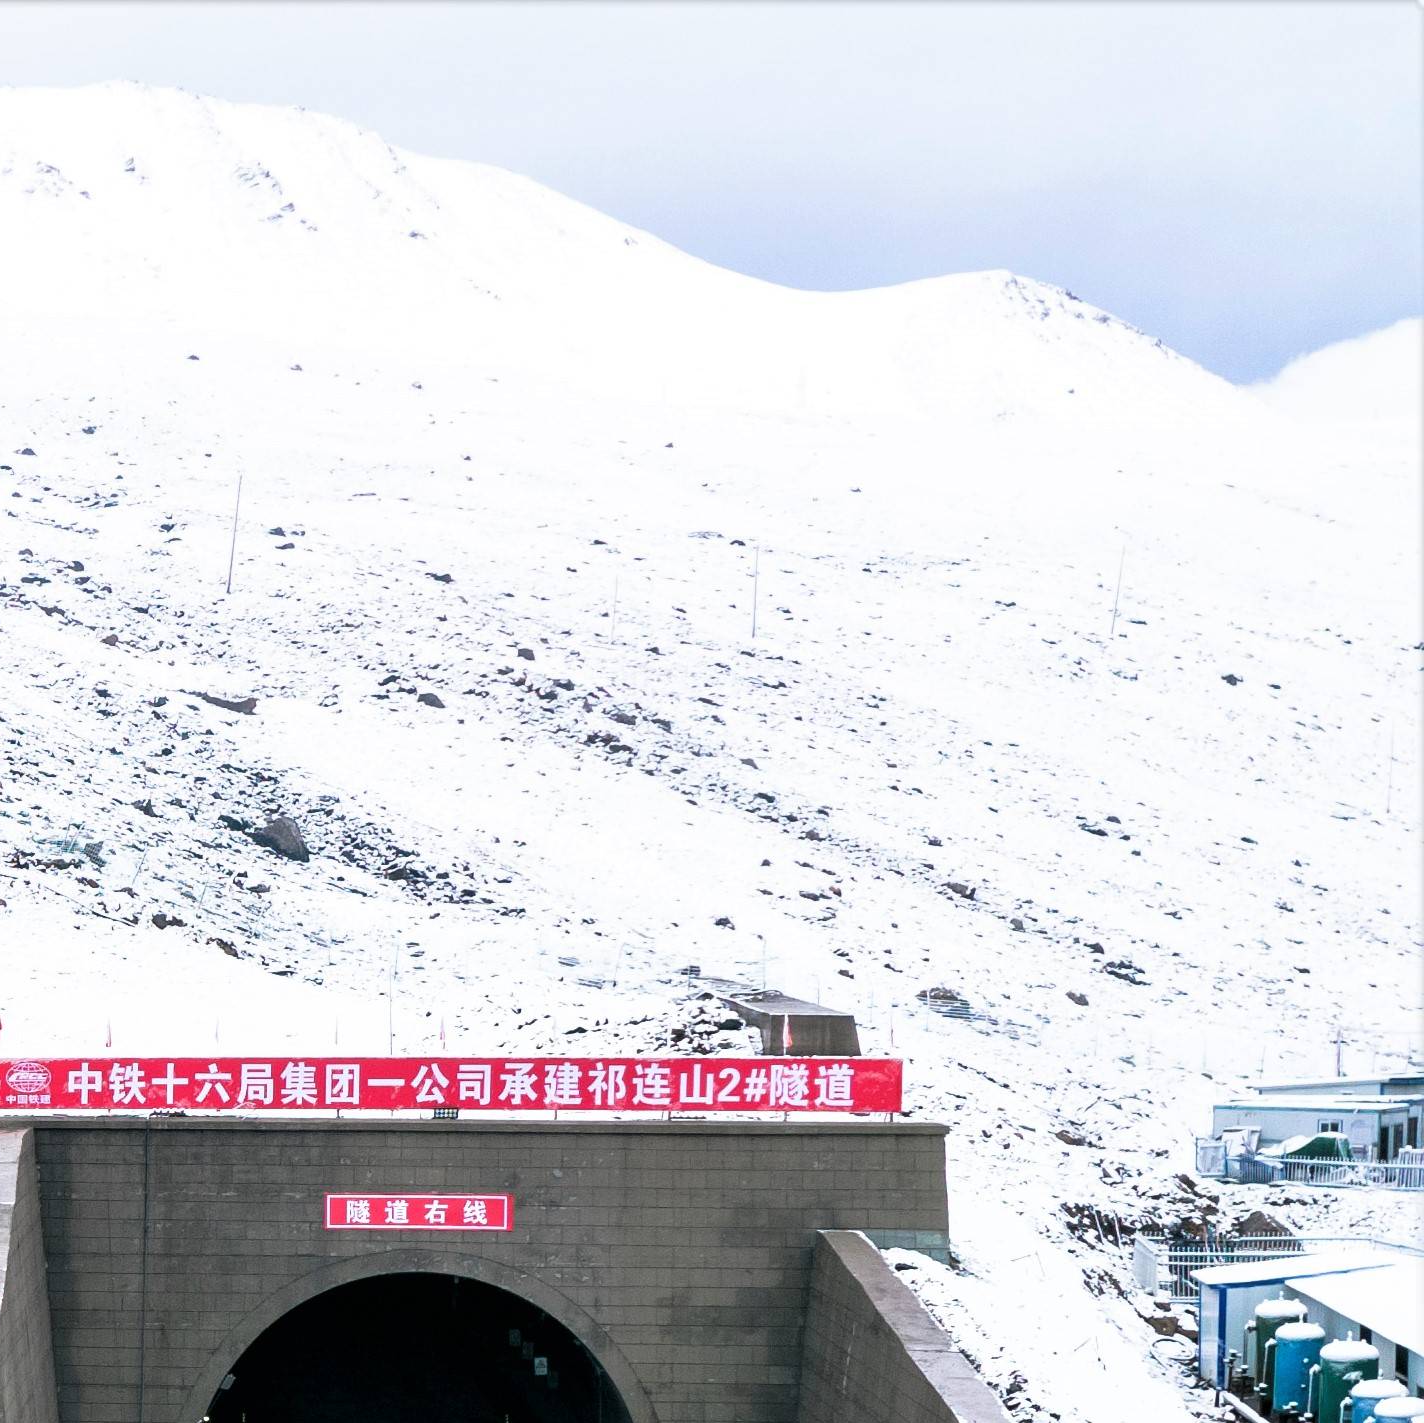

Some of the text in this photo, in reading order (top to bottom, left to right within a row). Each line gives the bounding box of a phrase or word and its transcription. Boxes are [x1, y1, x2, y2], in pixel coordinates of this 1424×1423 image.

[67, 1061, 854, 1107] 中铁十六局集团一公司承建祁连山2#隧道
[346, 1199, 488, 1225] 隧道右线
